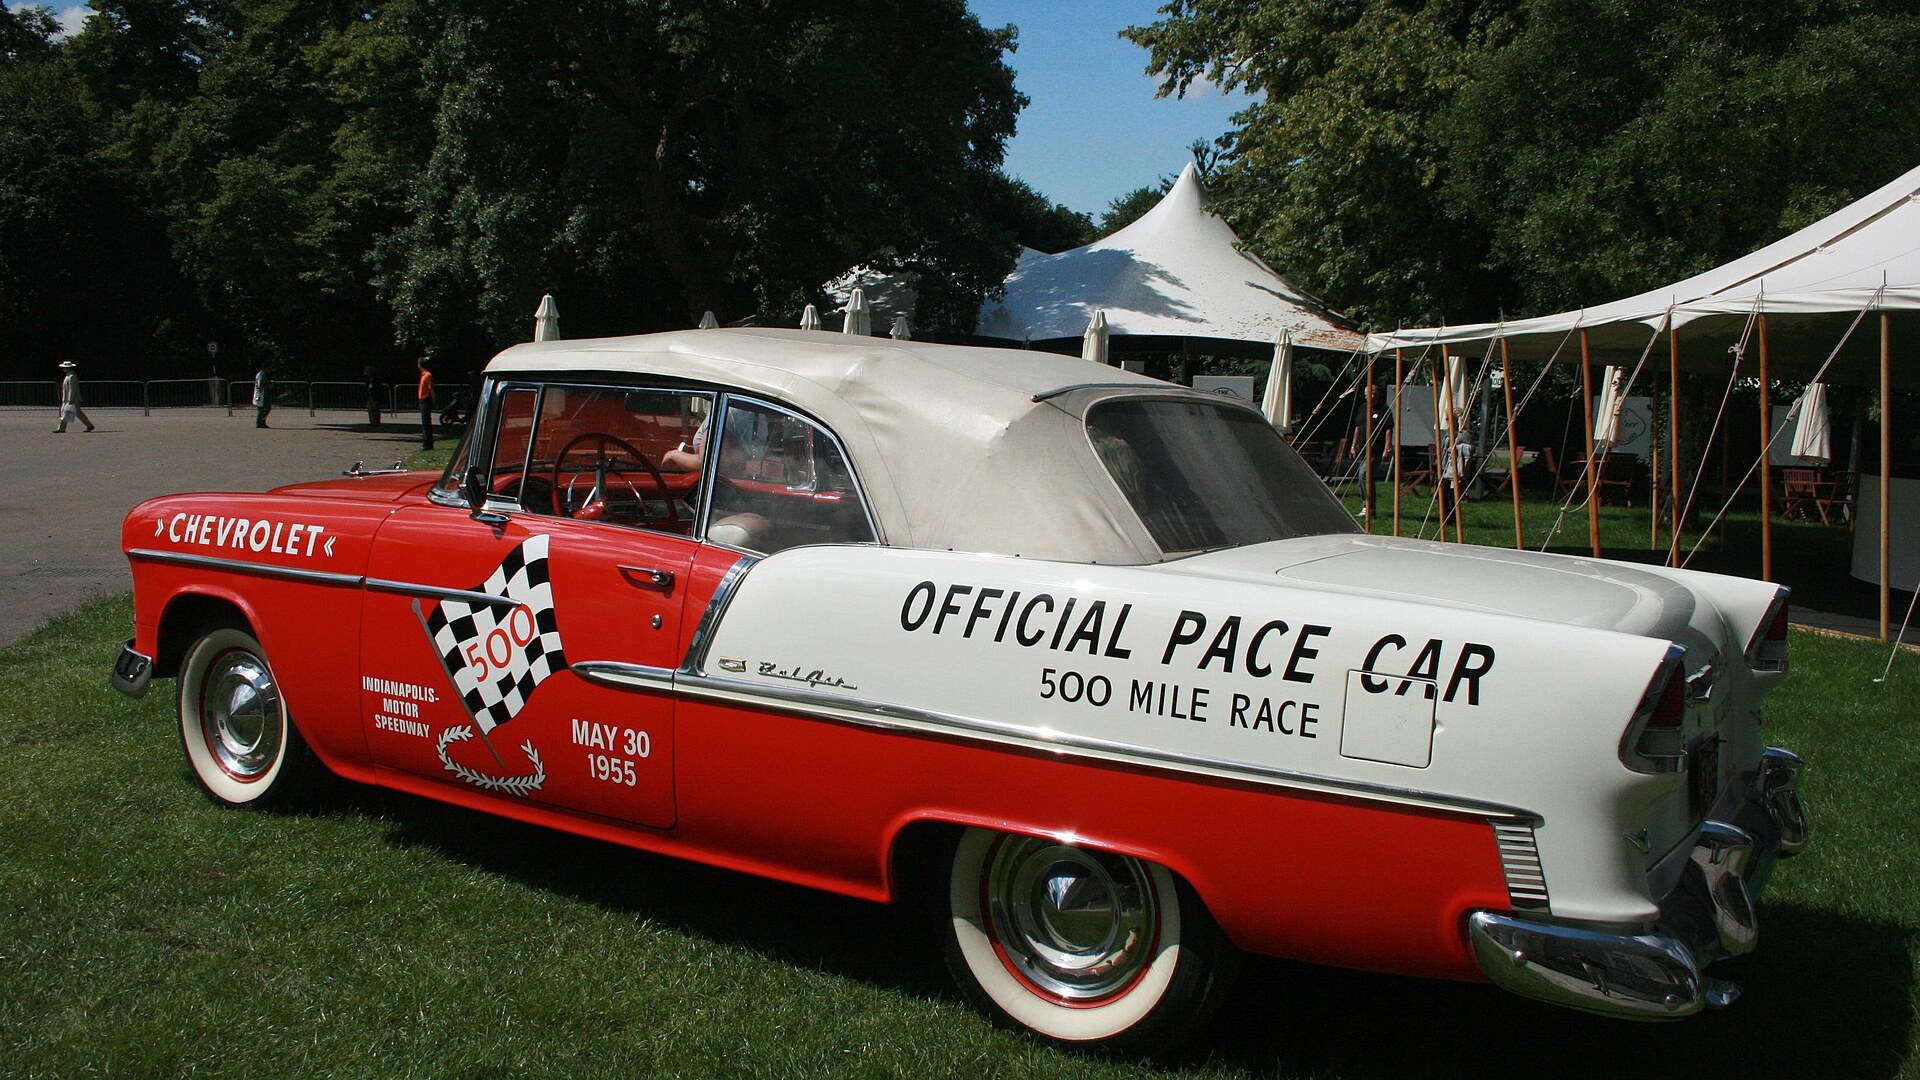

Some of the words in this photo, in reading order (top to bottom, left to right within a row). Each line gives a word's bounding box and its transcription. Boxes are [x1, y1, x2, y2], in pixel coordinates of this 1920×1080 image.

[169, 512, 325, 557] CHEVROLET
[465, 603, 535, 683] 500
[900, 580, 1133, 660] OFFICIAL
[1160, 609, 1332, 684] PACE
[1360, 633, 1496, 707] CAR
[383, 697, 419, 718] MOTOR
[1040, 667, 1112, 707] 500
[1129, 678, 1210, 723] MILE
[1229, 693, 1320, 739] RACE
[374, 714, 431, 739] SPEEDWAY
[572, 718, 618, 751] MAY
[623, 728, 650, 758] 30
[587, 753, 637, 787] 1955
